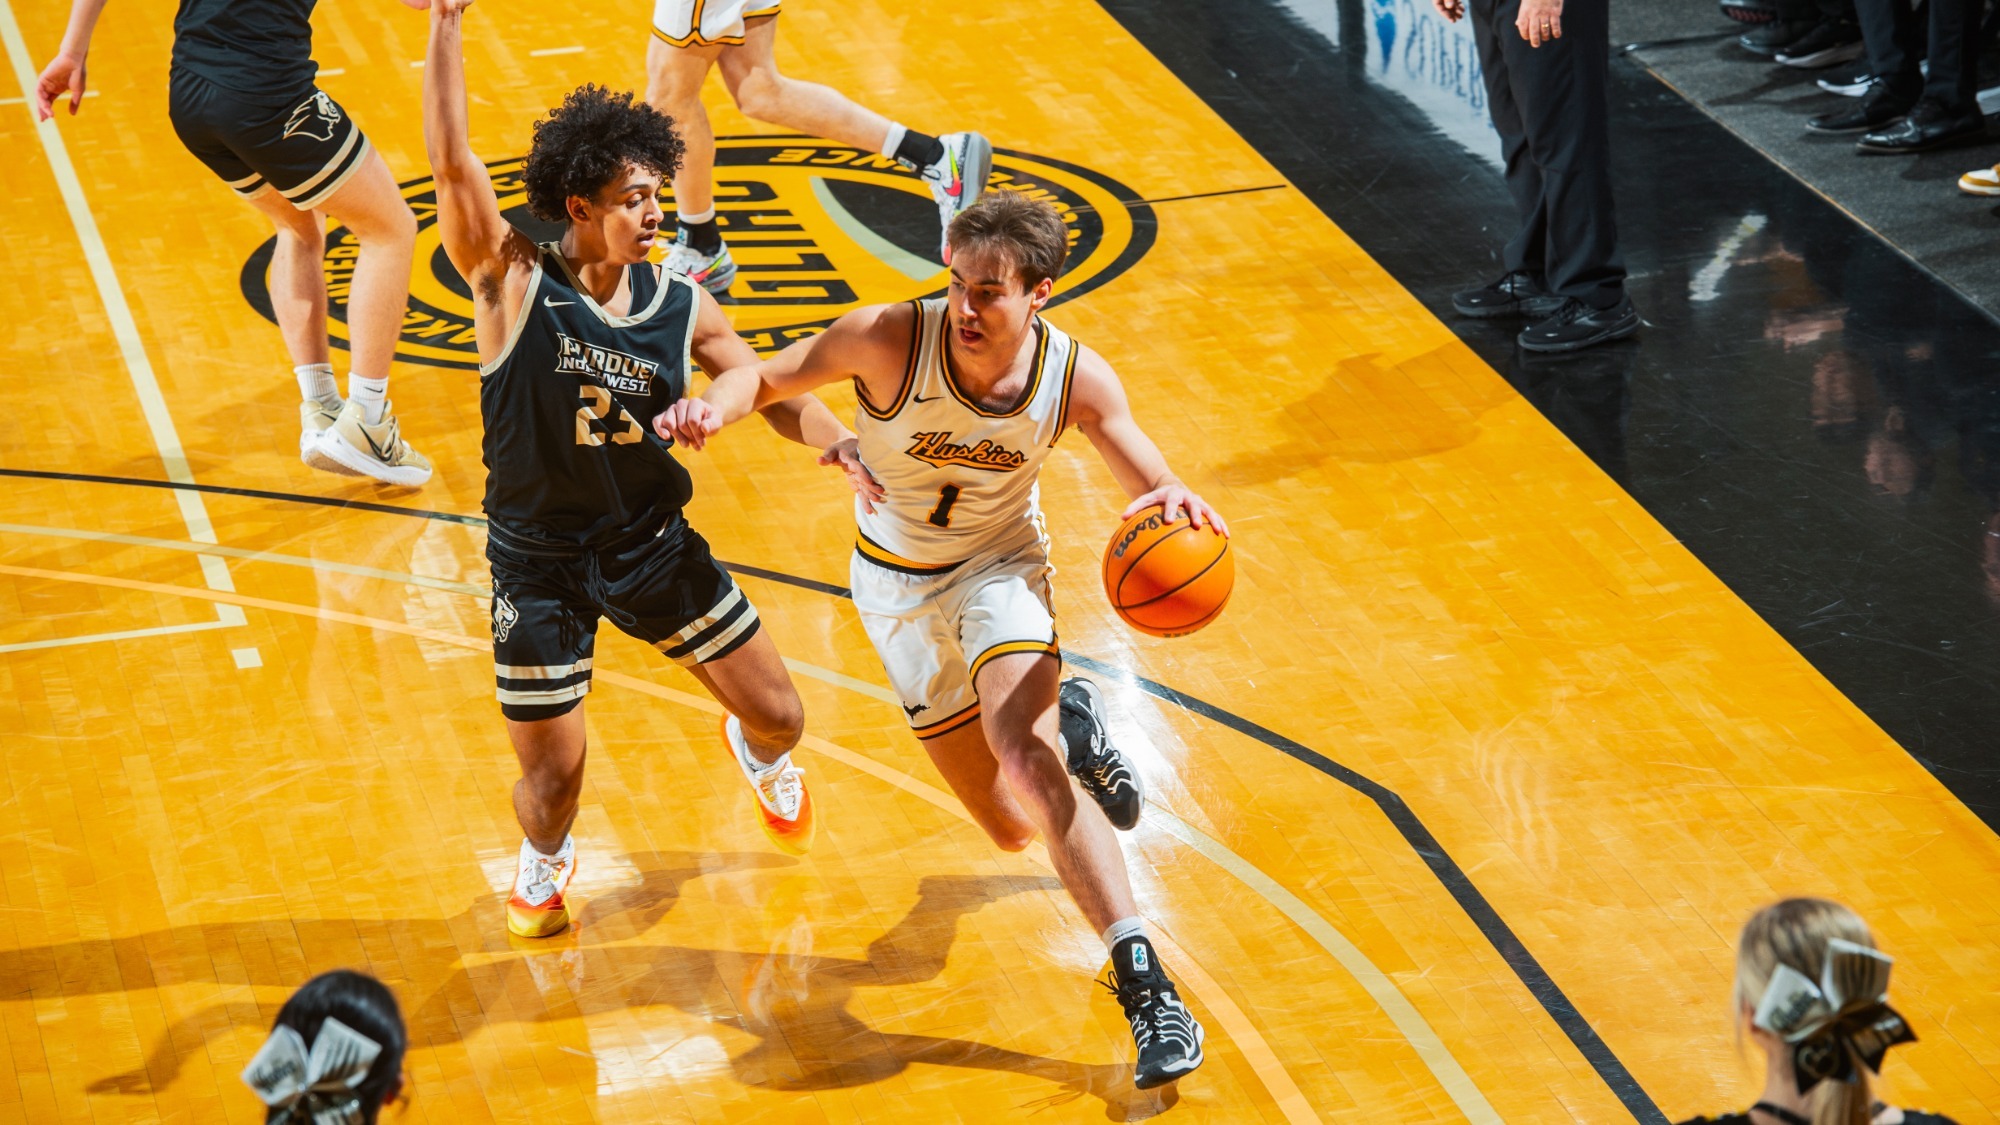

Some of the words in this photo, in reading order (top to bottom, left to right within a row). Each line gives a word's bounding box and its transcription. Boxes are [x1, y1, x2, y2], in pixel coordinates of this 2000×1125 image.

[563, 338, 653, 379] PURDUE
[563, 357, 647, 392] NORHWEST
[904, 431, 1029, 472] Huskies
[926, 481, 963, 529] 1
